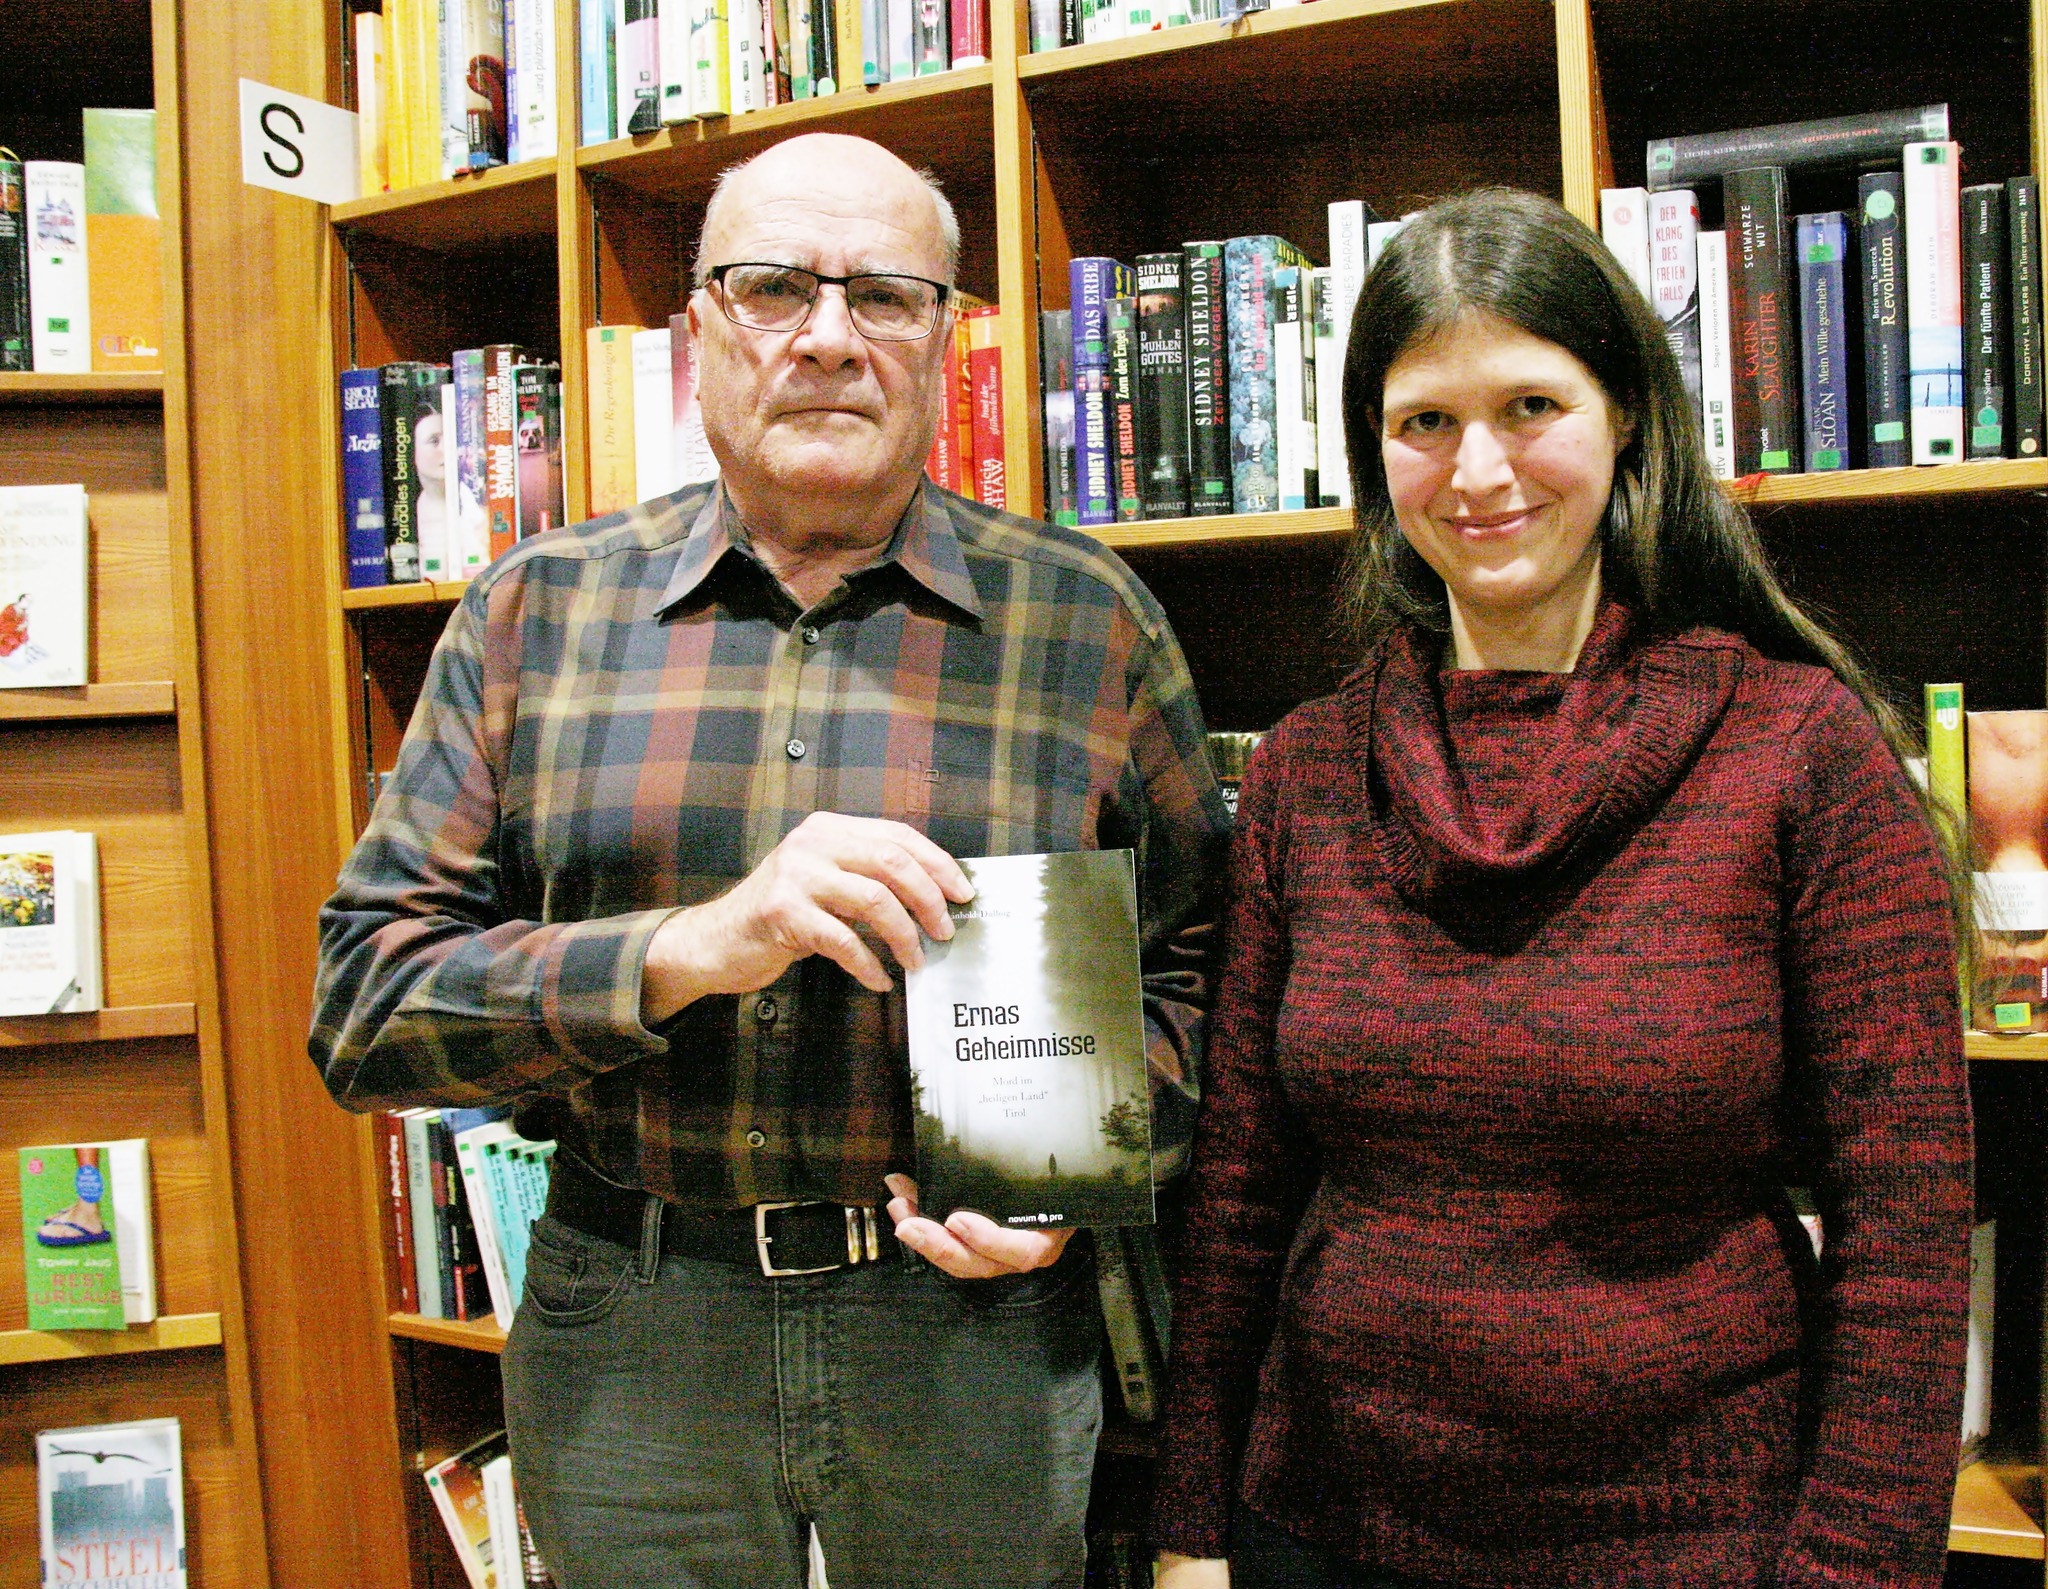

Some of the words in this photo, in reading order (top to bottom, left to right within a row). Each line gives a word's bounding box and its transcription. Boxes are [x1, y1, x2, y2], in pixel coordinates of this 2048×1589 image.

[260, 103, 304, 178] S
[1802, 132, 1850, 144] SLAUGHTER
[1852, 128, 1878, 138] KARIN
[1713, 146, 1737, 154] MEIN
[1660, 205, 1677, 222] DER
[1979, 200, 1988, 234] WELTBILD
[1341, 213, 1354, 270] PARADIES
[1656, 226, 1682, 242] KLANG
[1741, 204, 1754, 269] SCHWARZE
[1755, 224, 1766, 248] WUT
[2018, 211, 2030, 245] zuwenig
[1662, 246, 1678, 262] DES
[1083, 262, 1100, 304] ERBE
[1138, 264, 1179, 276] SIDNEY
[1138, 275, 1180, 290] SHELDON
[1656, 266, 1686, 282] FREIEN
[1709, 267, 1718, 298] Amerika
[1979, 262, 1991, 299] Patient
[2020, 268, 2029, 281] Ein
[1190, 257, 1210, 346] SHELDON
[1286, 284, 1298, 320] PIPER
[1659, 285, 1684, 302] FALLS
[1815, 278, 1830, 326] geschehe
[1929, 272, 1937, 319] DEBORAH
[2021, 286, 2030, 324] SAYERS
[1871, 298, 1879, 319] Boris
[1980, 301, 1992, 333] fünfte
[1085, 306, 1101, 340] DAS
[1140, 328, 1182, 342] DIE
[1711, 308, 1720, 340] Verloren
[2022, 325, 2030, 335] L.
[1112, 330, 1129, 356] Engel
[1744, 321, 1760, 377] KARIN
[1759, 292, 1780, 401] SLAUGHTER
[1816, 328, 1829, 355] Wille
[1981, 336, 1993, 354] Der
[1115, 358, 1128, 374] der
[1140, 352, 1182, 366] GOTTES
[1142, 366, 1182, 378] ROMAN
[1213, 358, 1224, 386] DER
[1254, 352, 1267, 371] Der
[1817, 358, 1830, 384] Mein
[2022, 337, 2032, 385] DOROTHY
[487, 376, 497, 390] IM
[498, 352, 512, 431] MORGENGRAUEN
[520, 376, 536, 385] TOM
[603, 344, 616, 421] Regenkönigin
[981, 384, 989, 398] der
[1115, 375, 1130, 400] Zorn
[1194, 356, 1212, 426] SIDNEY
[1982, 368, 1993, 395] Serfaty
[345, 396, 380, 410] SEGAL
[489, 392, 499, 432] GESANG
[1085, 392, 1103, 448] SHELDON
[1118, 404, 1134, 455] SHELDON
[1814, 407, 1822, 434] SUSAN
[1821, 392, 1837, 448] SLOAN
[393, 417, 412, 480] betrogen
[604, 424, 615, 446] Die
[1760, 428, 1770, 452] nvalet
[938, 438, 948, 469] SHAW
[1252, 439, 1261, 462] Alex
[496, 444, 514, 499] SEYMOUR
[1087, 450, 1105, 497] SIDNEY
[1120, 459, 1137, 499] SIDNEY
[1714, 456, 1726, 475] dtv
[980, 459, 993, 505] atricia
[394, 484, 410, 545] Paradies
[952, 910, 977, 920] inhold
[952, 1002, 1020, 1028] Ernas
[956, 1032, 1096, 1062] Geheimnisse
[992, 1076, 1018, 1086] Mord
[1020, 1076, 1034, 1085] im
[1004, 1108, 1027, 1118] Tirol
[1008, 1214, 1036, 1223] novum
[1049, 1213, 1064, 1222] pro
[52, 1273, 104, 1288] REST
[55, 1536, 174, 1584] STEEL
